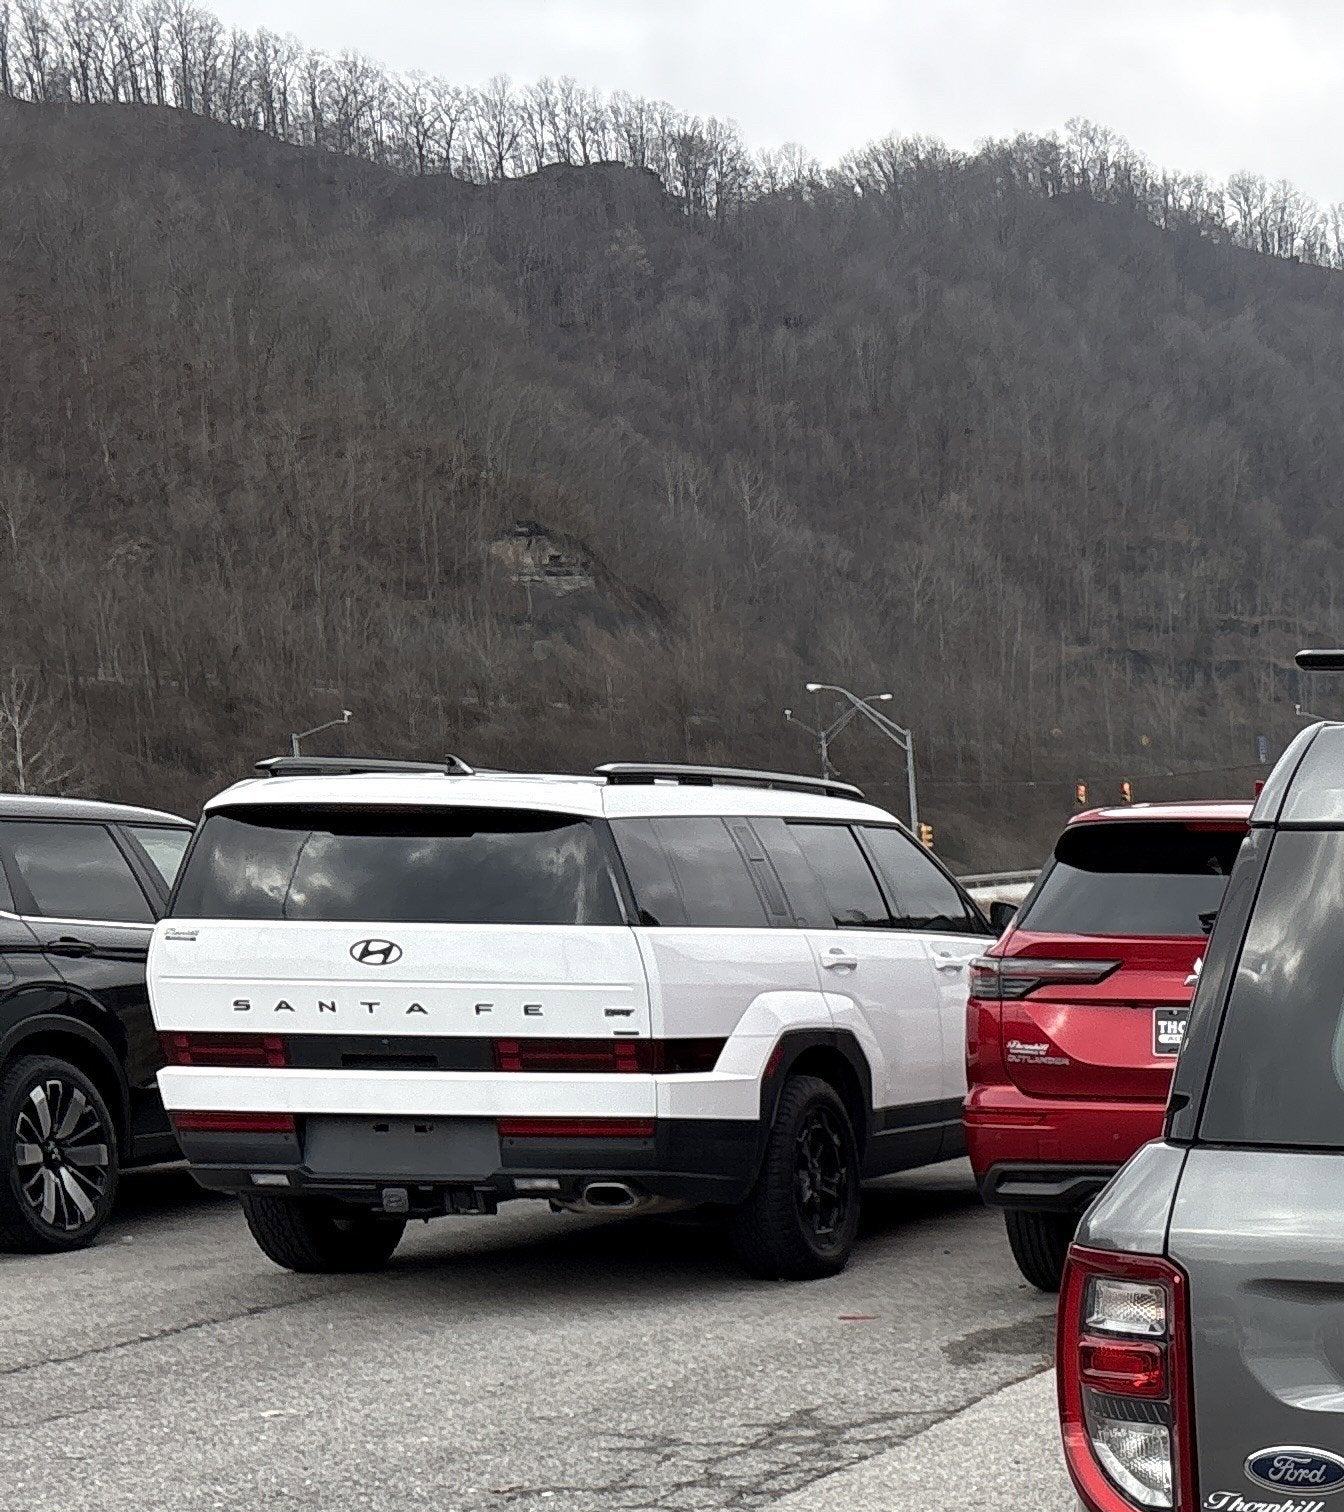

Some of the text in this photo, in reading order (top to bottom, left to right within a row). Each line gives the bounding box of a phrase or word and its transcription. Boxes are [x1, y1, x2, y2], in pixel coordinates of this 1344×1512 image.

[232, 999, 543, 1017] SANTA FE
[1267, 1455, 1327, 1484] Ford
